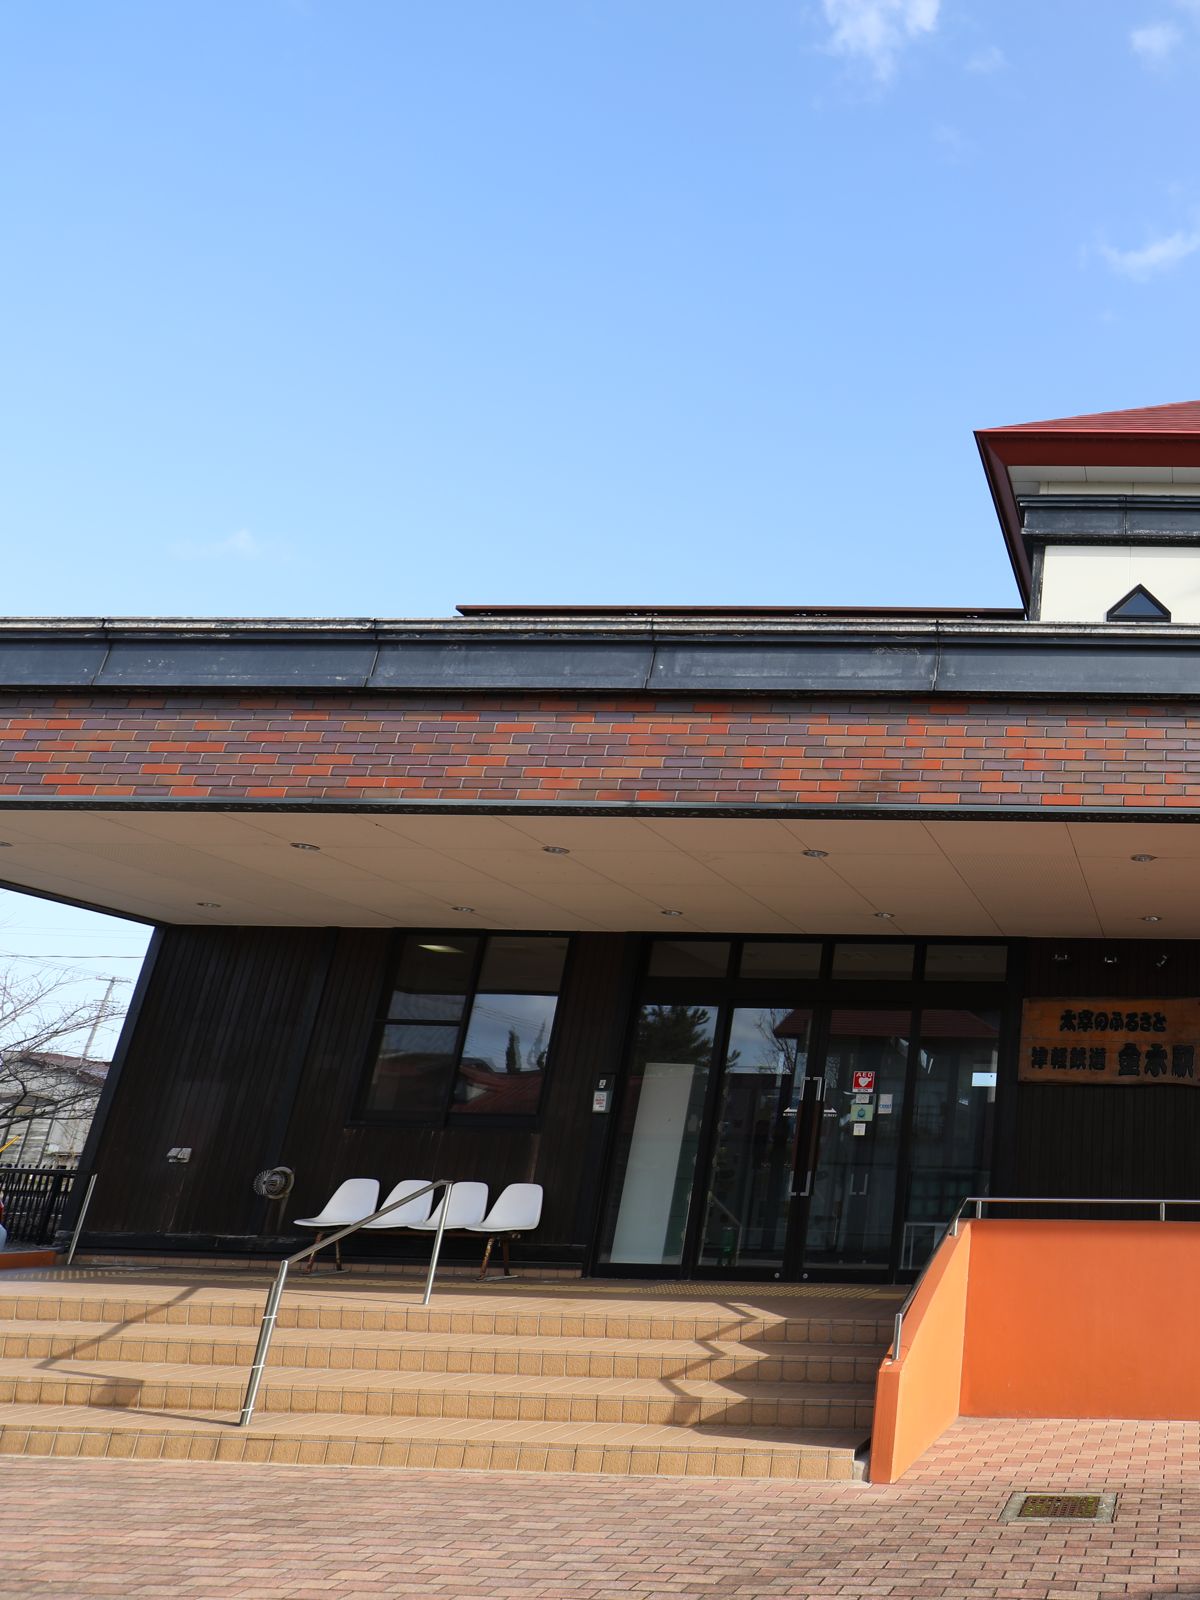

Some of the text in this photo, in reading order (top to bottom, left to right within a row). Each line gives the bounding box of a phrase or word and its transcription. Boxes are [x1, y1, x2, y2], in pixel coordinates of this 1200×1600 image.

[1059, 1009, 1168, 1033] 太宰のふるさと
[1118, 1042, 1195, 1078] 金木駅
